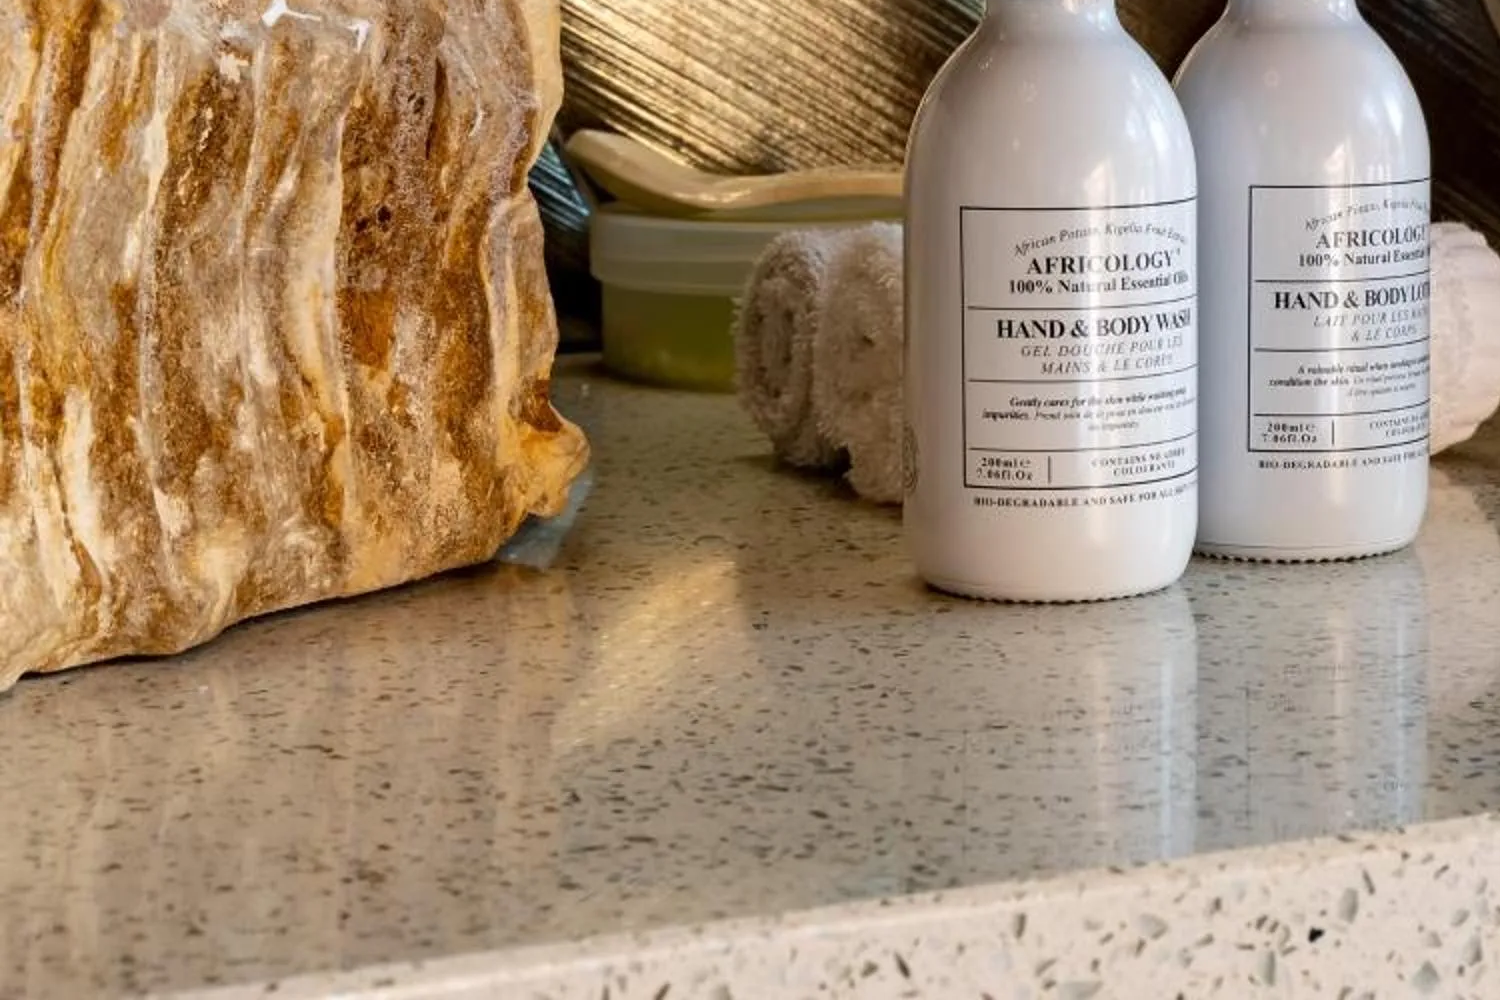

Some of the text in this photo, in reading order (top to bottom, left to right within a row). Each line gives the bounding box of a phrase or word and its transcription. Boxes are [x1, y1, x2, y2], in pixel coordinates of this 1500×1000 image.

[1015, 235, 1056, 257] African
[1027, 250, 1172, 275] AFRICOLOGY
[1299, 253, 1338, 267] 100%
[1344, 251, 1390, 266] Natural
[1009, 279, 1053, 295] 100%
[1058, 278, 1116, 293] Natural
[1121, 272, 1169, 291] Essential
[1274, 291, 1339, 309] HAND
[1343, 290, 1360, 308] &
[1365, 287, 1407, 307] BODY
[996, 307, 1191, 339] HAND & BODY WASH
[1021, 345, 1051, 357] GEL
[1058, 341, 1125, 357] DOUCHE
[1131, 338, 1163, 354] POUR
[1041, 361, 1090, 375] MAINS
[1114, 358, 1130, 371] LE
[1135, 354, 1174, 370] CORPS
[1071, 396, 1086, 408] for
[974, 495, 1077, 508] BIO-DEGRADABLE
[1084, 493, 1106, 506] AND
[1109, 494, 1134, 505] SAFE
